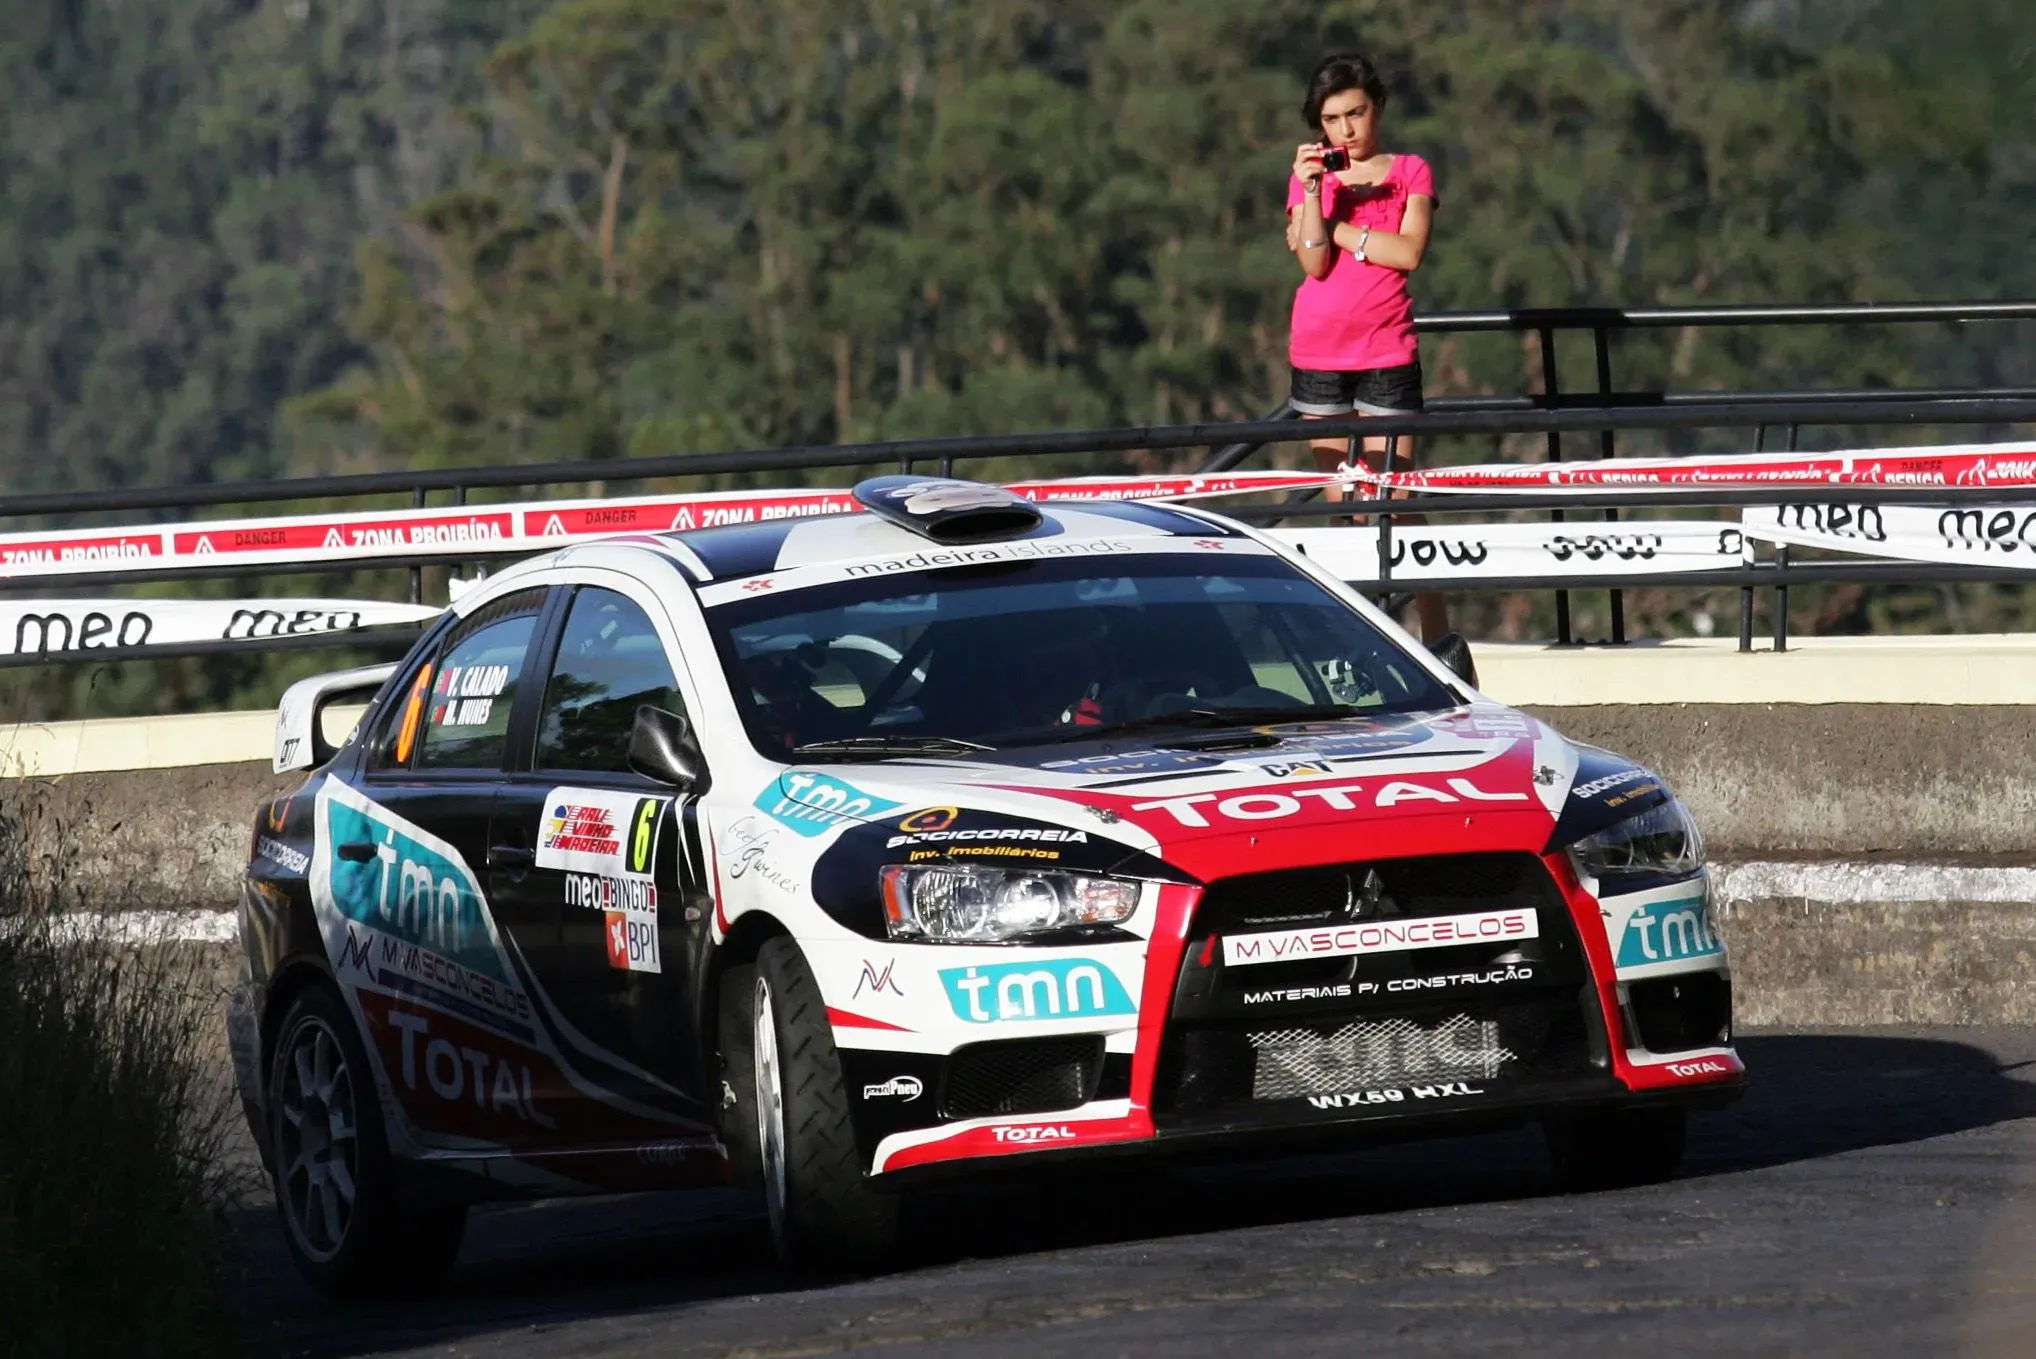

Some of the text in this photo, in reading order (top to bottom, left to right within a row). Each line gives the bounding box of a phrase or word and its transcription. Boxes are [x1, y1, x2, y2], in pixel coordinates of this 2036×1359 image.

[585, 510, 636, 524] DANGER
[702, 507, 755, 528] ZONA
[235, 531, 286, 546] DANGER
[352, 527, 404, 548] ZONA
[845, 538, 1133, 577] madeira islands
[15, 611, 153, 656] meo
[447, 664, 509, 697] V. CALADO
[1259, 759, 1335, 779] CAT
[772, 773, 872, 825] tmn
[1130, 777, 1529, 828] TOTAL
[633, 799, 657, 872] 6
[886, 829, 1089, 849] SOCICORREIA
[377, 827, 461, 954] tmn
[564, 873, 602, 910] meo
[628, 921, 656, 964] BPI
[957, 965, 1105, 1022] tmn
[1244, 984, 1352, 1004] MATERIAIS
[1388, 966, 1533, 993] CONSTRUÇÃO
[388, 1008, 559, 1132] TOTAL
[1665, 1061, 1727, 1078] TOTAL
[1411, 1082, 1484, 1100] HXL
[992, 1125, 1076, 1142] TOTAL
